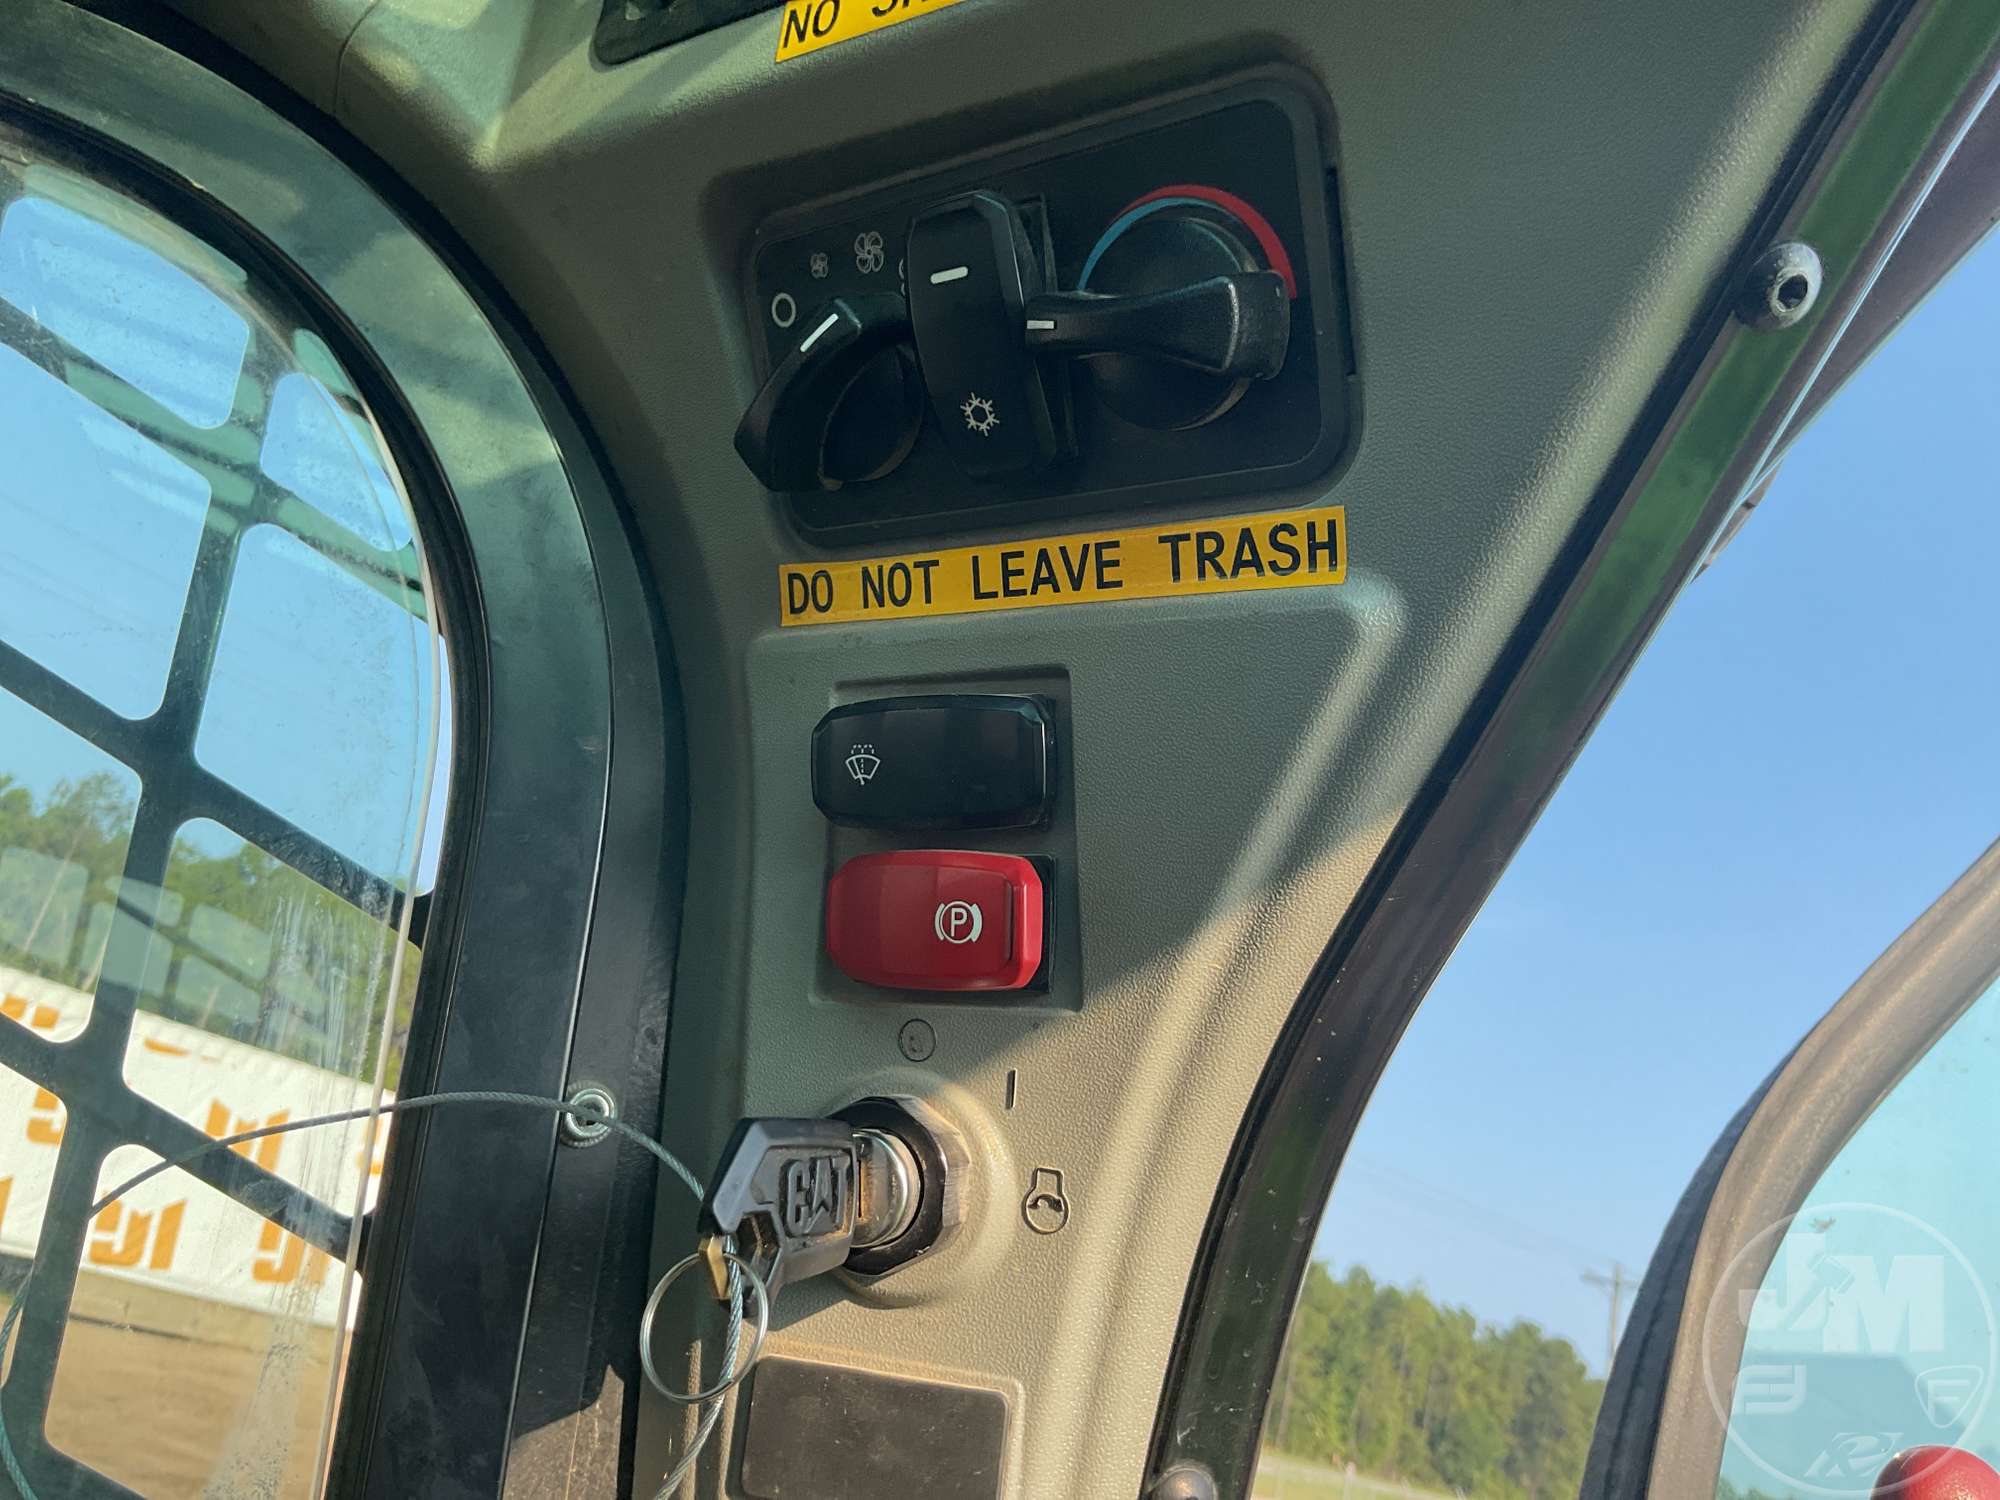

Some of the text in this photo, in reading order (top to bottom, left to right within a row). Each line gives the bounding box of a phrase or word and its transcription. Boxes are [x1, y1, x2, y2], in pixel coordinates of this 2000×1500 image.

[783, 0, 840, 48] NO
[787, 518, 1338, 615] DO NOT LEAVE TRASH
[786, 1157, 851, 1236] CAT
